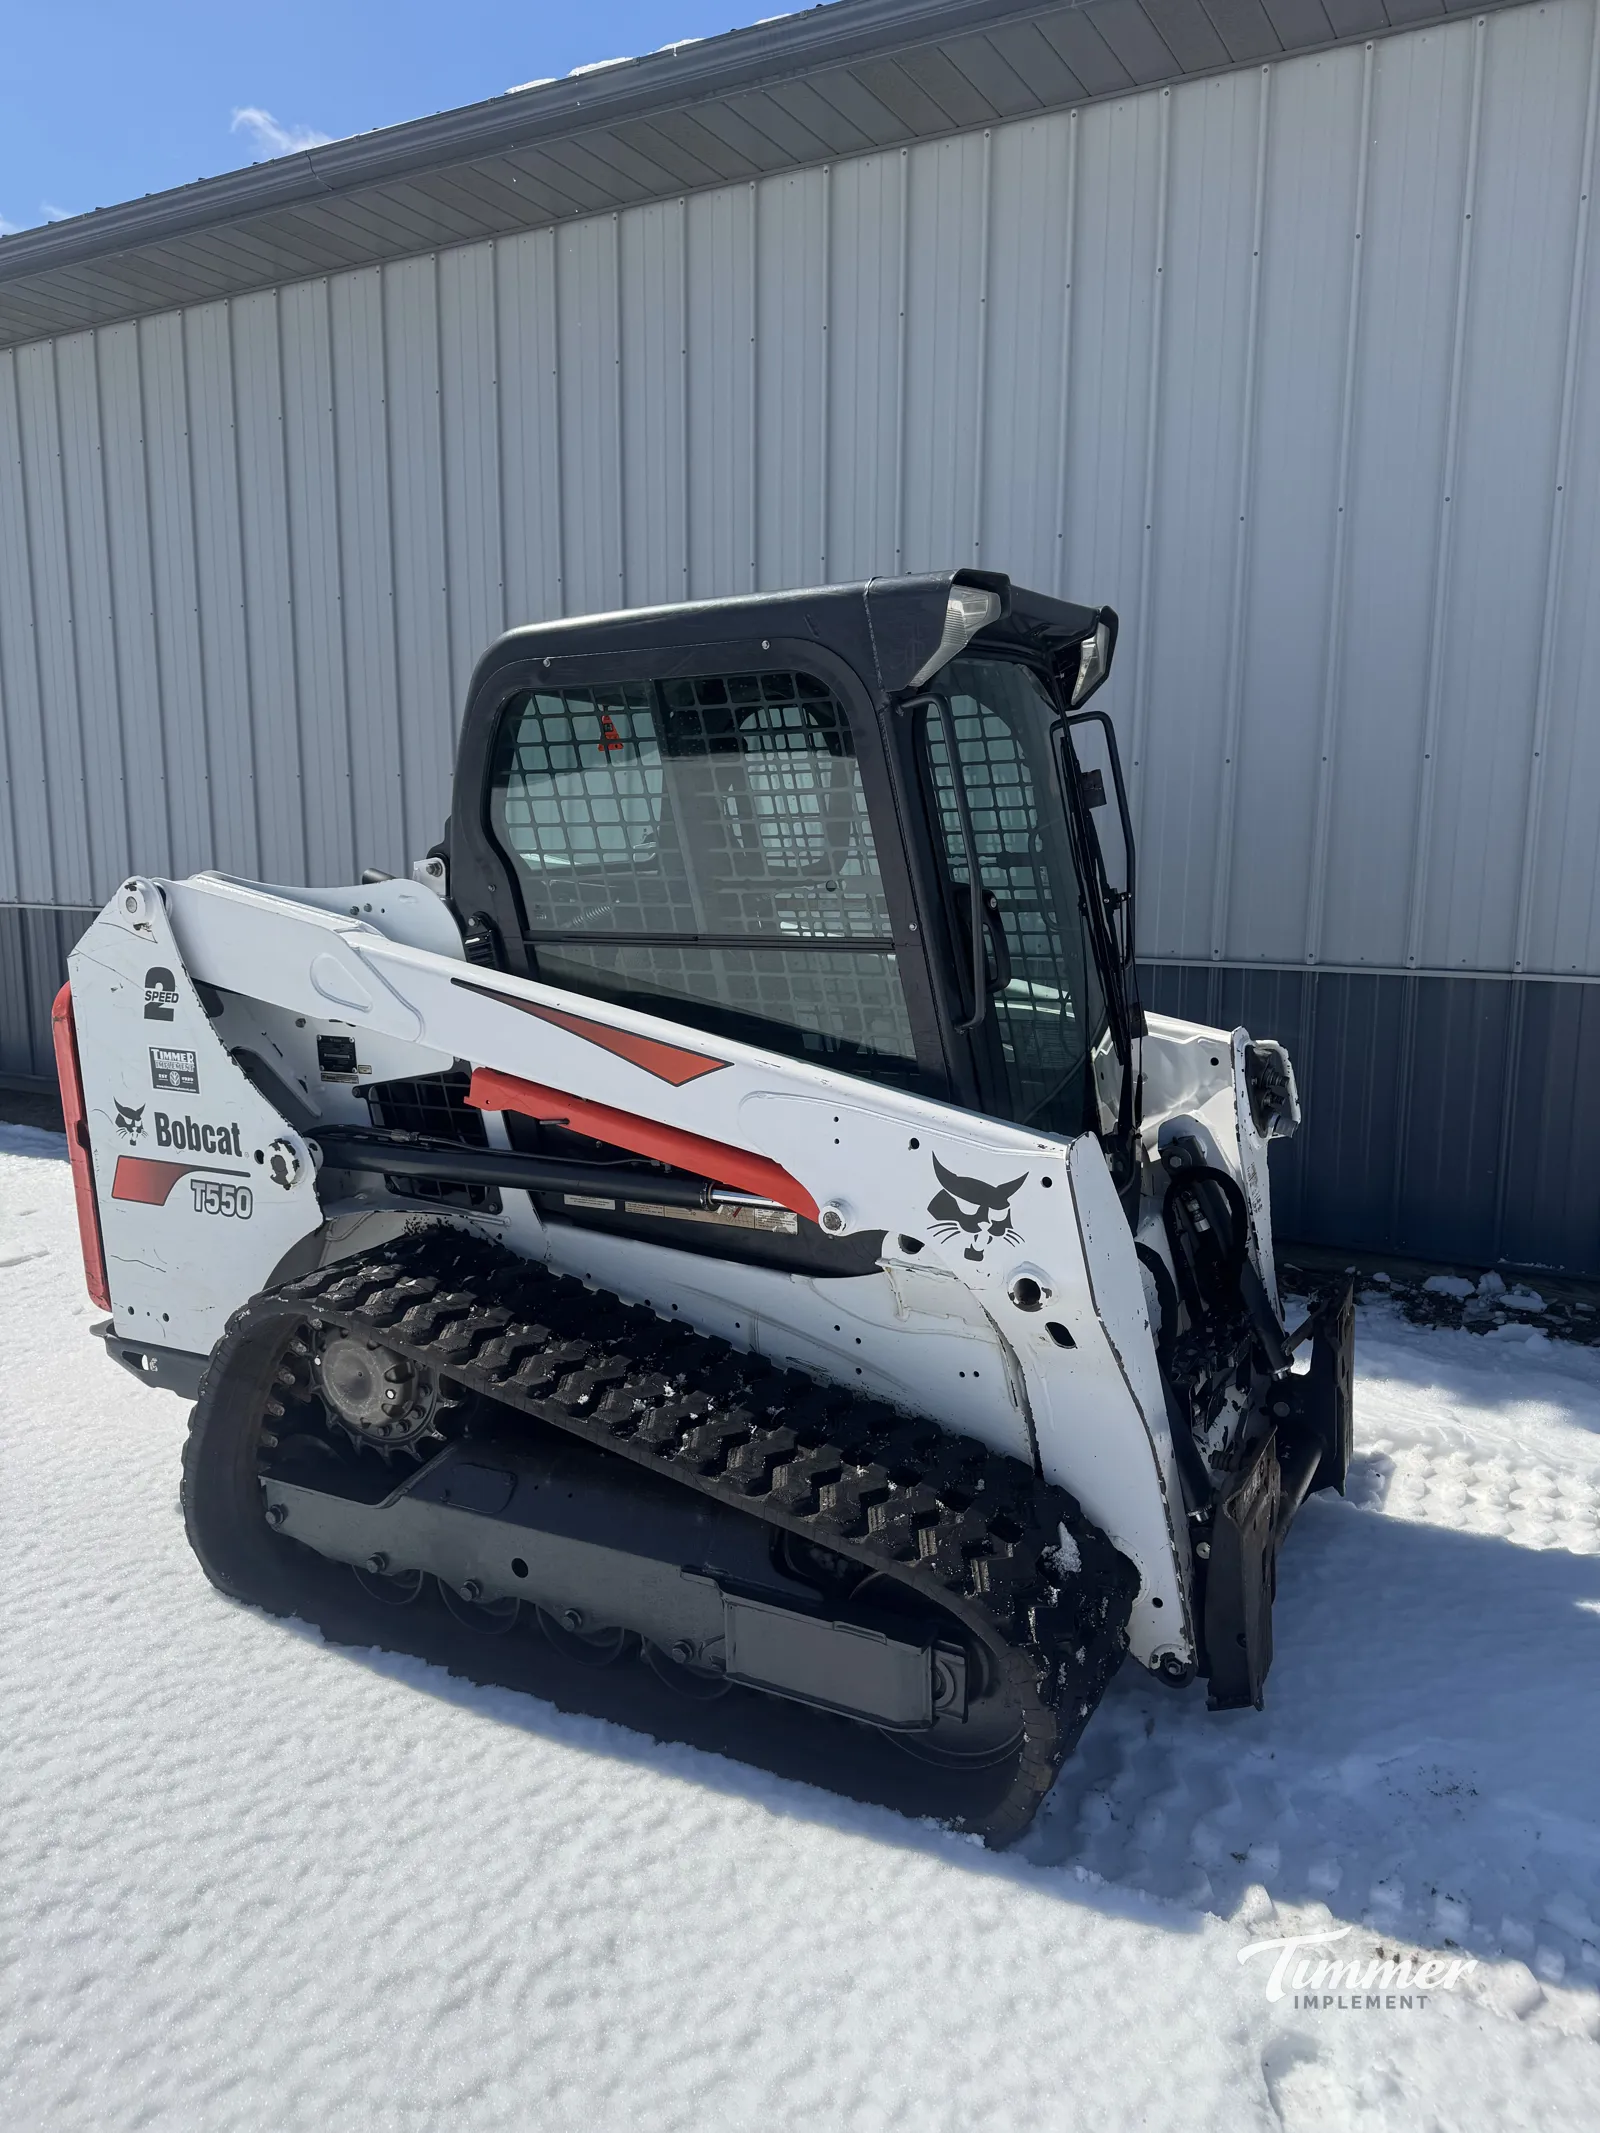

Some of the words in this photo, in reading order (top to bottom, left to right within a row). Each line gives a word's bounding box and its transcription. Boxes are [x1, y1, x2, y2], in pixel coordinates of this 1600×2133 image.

[144, 966, 176, 1022] 2
[144, 990, 179, 1004] SPEED
[151, 1049, 194, 1064] TIMMER
[154, 1112, 243, 1157] Bobcat
[190, 1178, 253, 1220] T550
